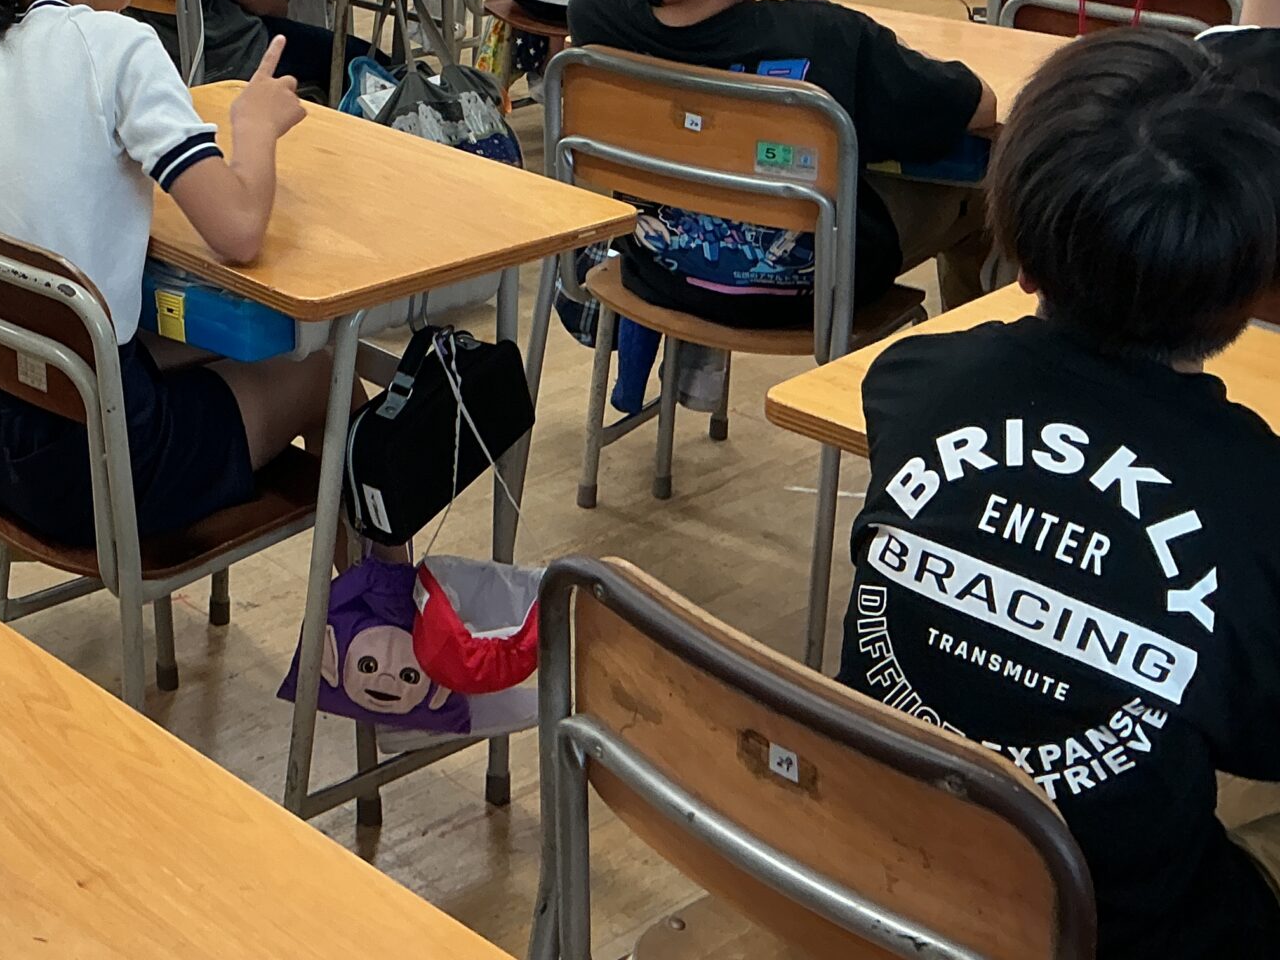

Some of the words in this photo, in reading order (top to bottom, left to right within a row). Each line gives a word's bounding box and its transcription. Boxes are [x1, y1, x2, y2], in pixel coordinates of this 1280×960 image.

[765, 148, 776, 159] 5
[885, 419, 1217, 633] BRISKLY
[978, 494, 1111, 576] ENTER
[878, 534, 1177, 683] BRACING
[927, 628, 1070, 701] TRANSMUTE
[981, 697, 1146, 774] XPANSE
[1034, 707, 1168, 800] TRIEVE
